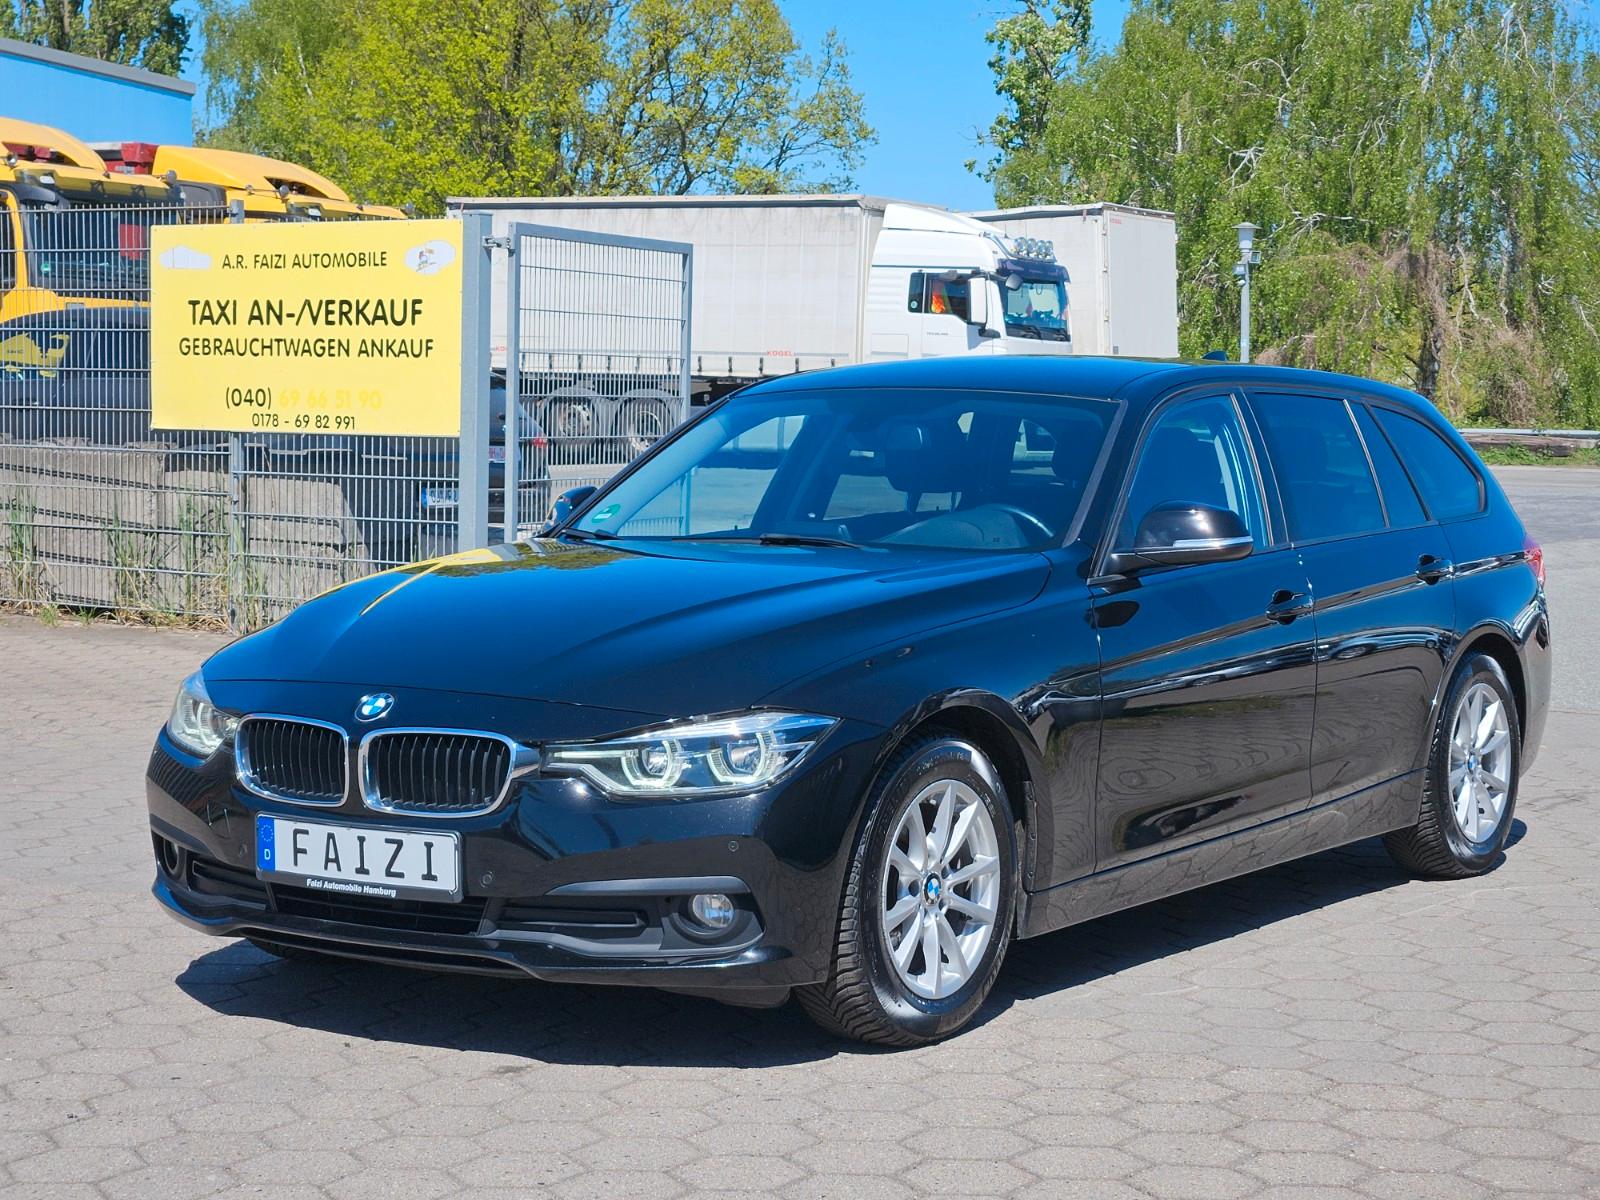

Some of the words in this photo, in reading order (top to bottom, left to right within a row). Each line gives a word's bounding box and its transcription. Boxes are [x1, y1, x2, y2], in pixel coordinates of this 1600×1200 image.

[222, 254, 248, 270] A.R.
[253, 254, 286, 270] FAIZI
[291, 251, 388, 269] AUTOMOBILE
[187, 299, 237, 326] TAXI
[178, 337, 350, 358] GEBRAUCHTWAGEN
[357, 338, 434, 359] ANKAUF
[225, 386, 272, 410] (040)
[279, 389, 300, 408] 69
[307, 389, 328, 408] 66
[358, 389, 383, 410] 90
[251, 413, 279, 428] 0178
[294, 414, 310, 429] 69
[315, 415, 330, 429] 82
[334, 415, 355, 430] 991
[263, 848, 271, 860] D
[292, 828, 438, 881] FAIZI
[363, 885, 397, 898] Hamburg
